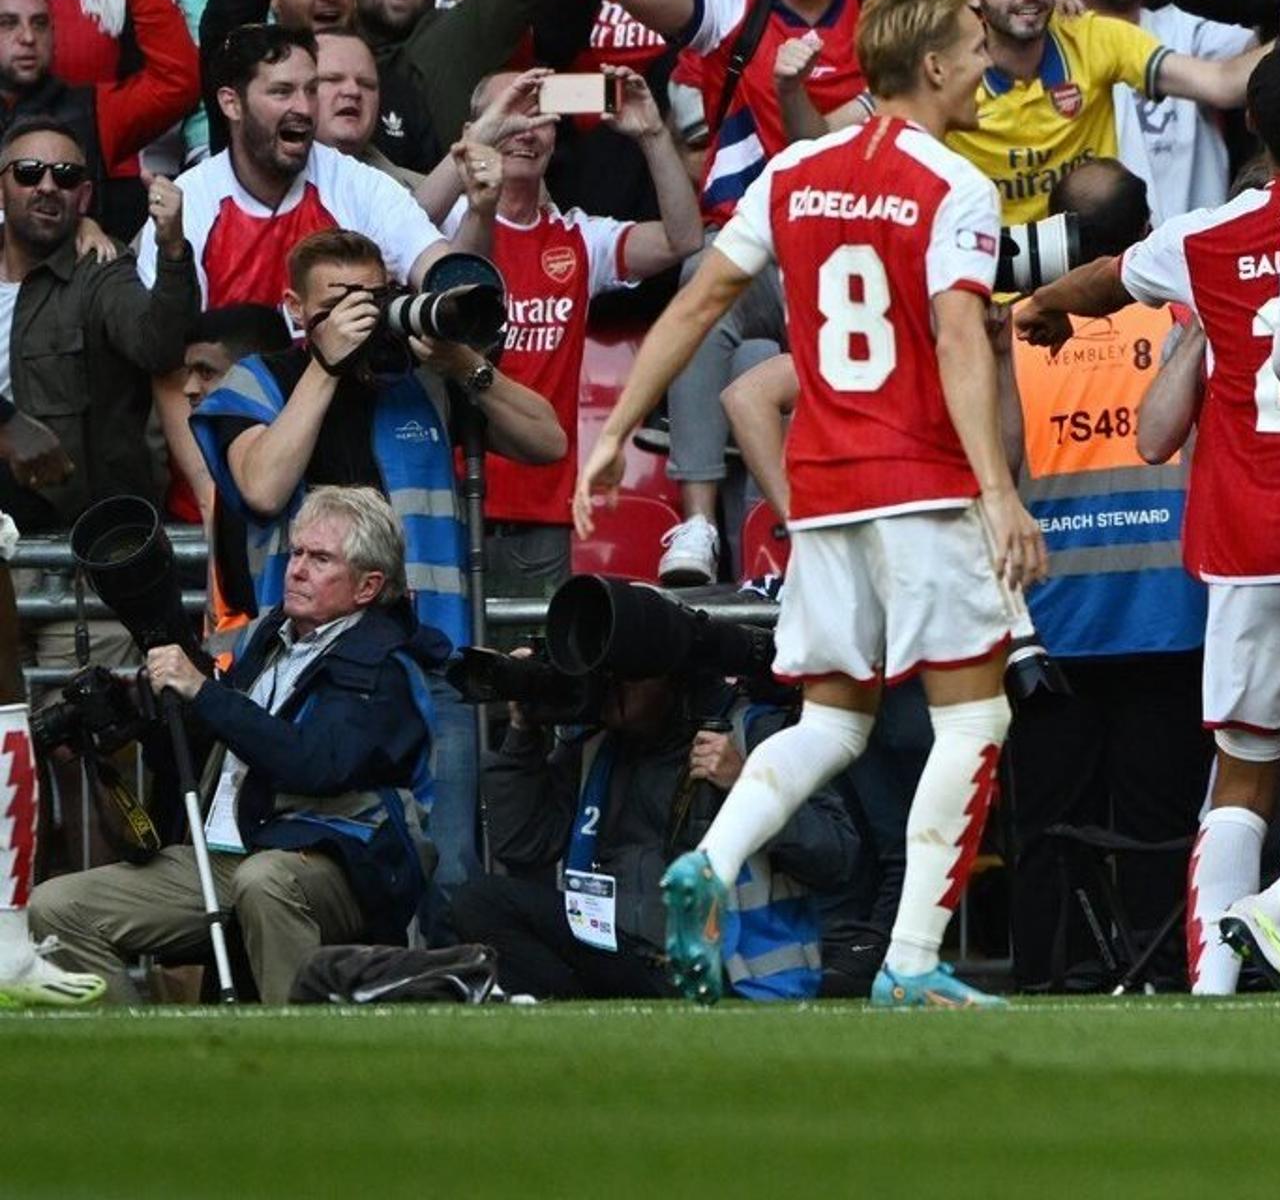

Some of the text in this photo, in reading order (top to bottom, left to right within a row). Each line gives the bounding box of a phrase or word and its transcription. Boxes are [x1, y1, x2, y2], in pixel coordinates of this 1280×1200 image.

[788, 186, 920, 227] ØDEGAARD
[818, 243, 897, 392] 8
[1045, 344, 1128, 367] WEMBLEY
[1050, 406, 1138, 445] TS48
[1096, 508, 1170, 528] STEWARD
[580, 806, 600, 836] 2
